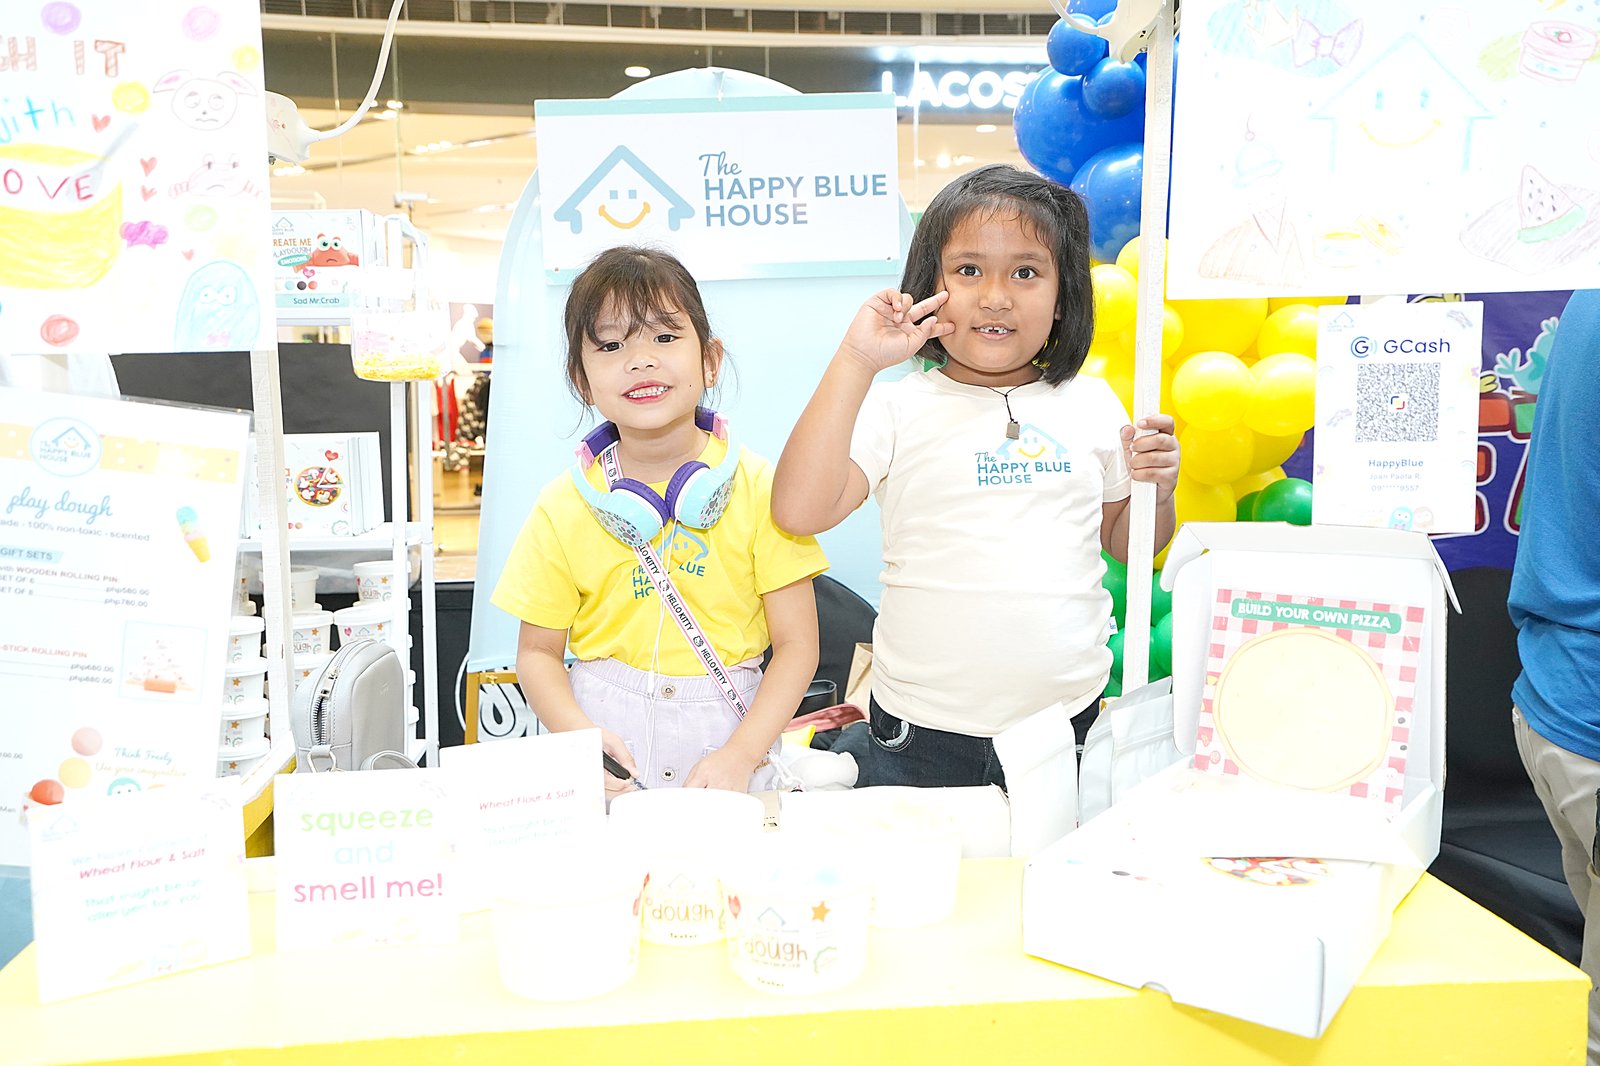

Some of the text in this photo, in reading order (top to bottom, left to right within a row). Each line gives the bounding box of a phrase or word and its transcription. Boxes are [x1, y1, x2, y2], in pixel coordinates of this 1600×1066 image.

[73, 39, 127, 78] IT
[699, 151, 743, 177] The
[704, 173, 889, 201] HAPPY BLUE
[705, 202, 808, 227] HOUSE
[300, 238, 312, 247] ME
[293, 297, 307, 305] Sad
[1383, 338, 1451, 354] GCash
[974, 451, 997, 463] The
[1368, 458, 1424, 470] HappyBlue
[977, 461, 1072, 475] HAPPY BLUE
[977, 473, 1033, 487] HOUSE
[6, 486, 113, 524] play dough
[57, 525, 102, 538] non-toxic
[110, 531, 151, 543] scented
[0, 547, 53, 561] GIFT SETS
[16, 566, 58, 577] WOODEN
[60, 570, 101, 582] ROLLING
[103, 575, 119, 583] PIN
[644, 555, 661, 575] KITTY
[15, 575, 26, 583] OF
[14, 587, 25, 595] OF
[666, 592, 695, 632] HELLO KITTY
[1238, 602, 1392, 629] BUILD YOUR OWN PIZZA
[31, 646, 70, 657] ROLLING
[72, 650, 88, 659] PIN
[700, 648, 728, 686] HELLO KITTY
[735, 701, 746, 718] HELL
[479, 797, 513, 811] Wheat
[556, 788, 575, 799] Salt
[300, 808, 434, 837] squeeze
[334, 840, 395, 865] and
[79, 862, 126, 879] Wheat
[130, 856, 163, 870] Flour
[168, 852, 176, 862] &
[182, 847, 206, 860] Salt
[294, 872, 443, 903] smell me!
[652, 903, 714, 922] dough
[744, 940, 808, 961] dough
